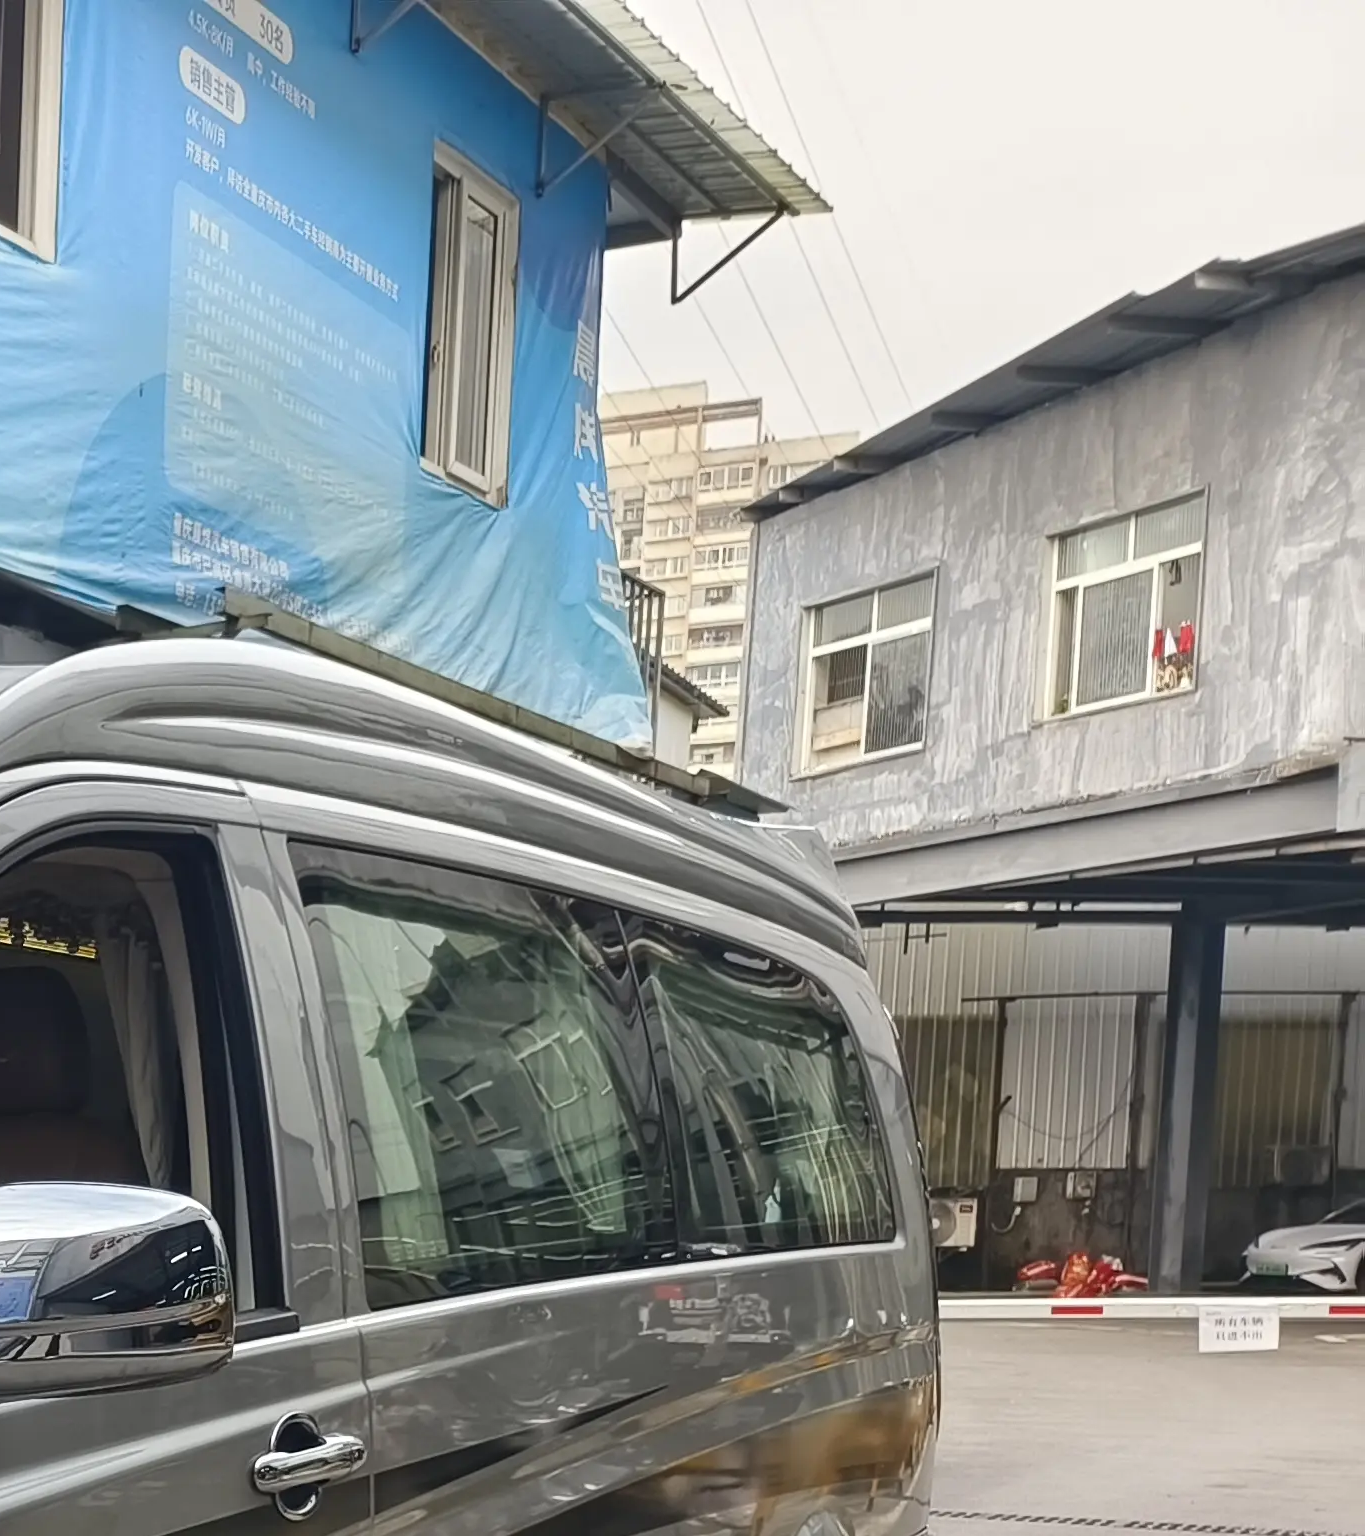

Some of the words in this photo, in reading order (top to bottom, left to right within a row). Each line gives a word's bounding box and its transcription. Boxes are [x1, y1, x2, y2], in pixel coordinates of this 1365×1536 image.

[259, 13, 284, 54] 30名
[190, 56, 236, 115] 销售主管
[185, 106, 226, 149] 6K-1W/月
